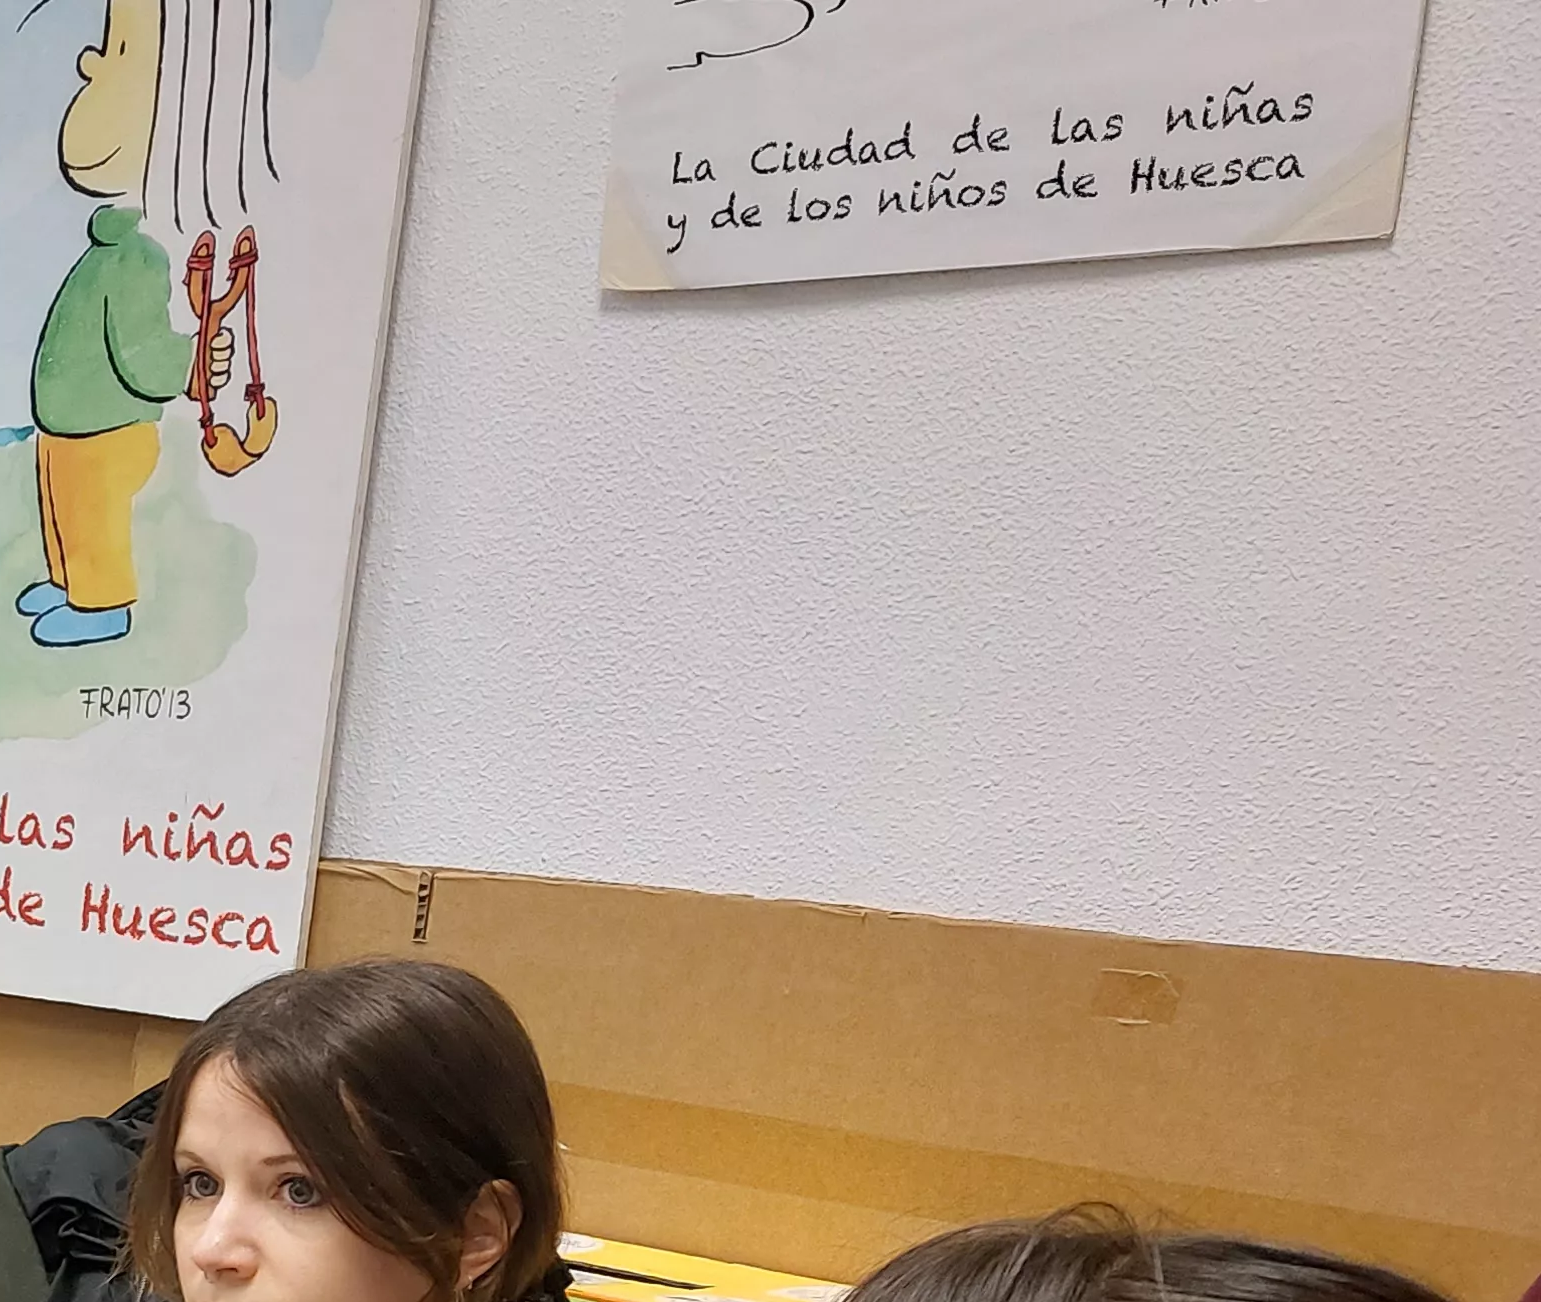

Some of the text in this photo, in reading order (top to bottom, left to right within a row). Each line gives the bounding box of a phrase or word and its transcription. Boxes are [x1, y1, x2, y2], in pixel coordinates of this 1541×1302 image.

[672, 80, 1314, 185] La Ciudad de las niñas
[666, 153, 1306, 255] y de los niños de Huesca
[80, 686, 192, 720] FRATO'13
[121, 803, 293, 870] niñas
[81, 882, 279, 954] Huesca
